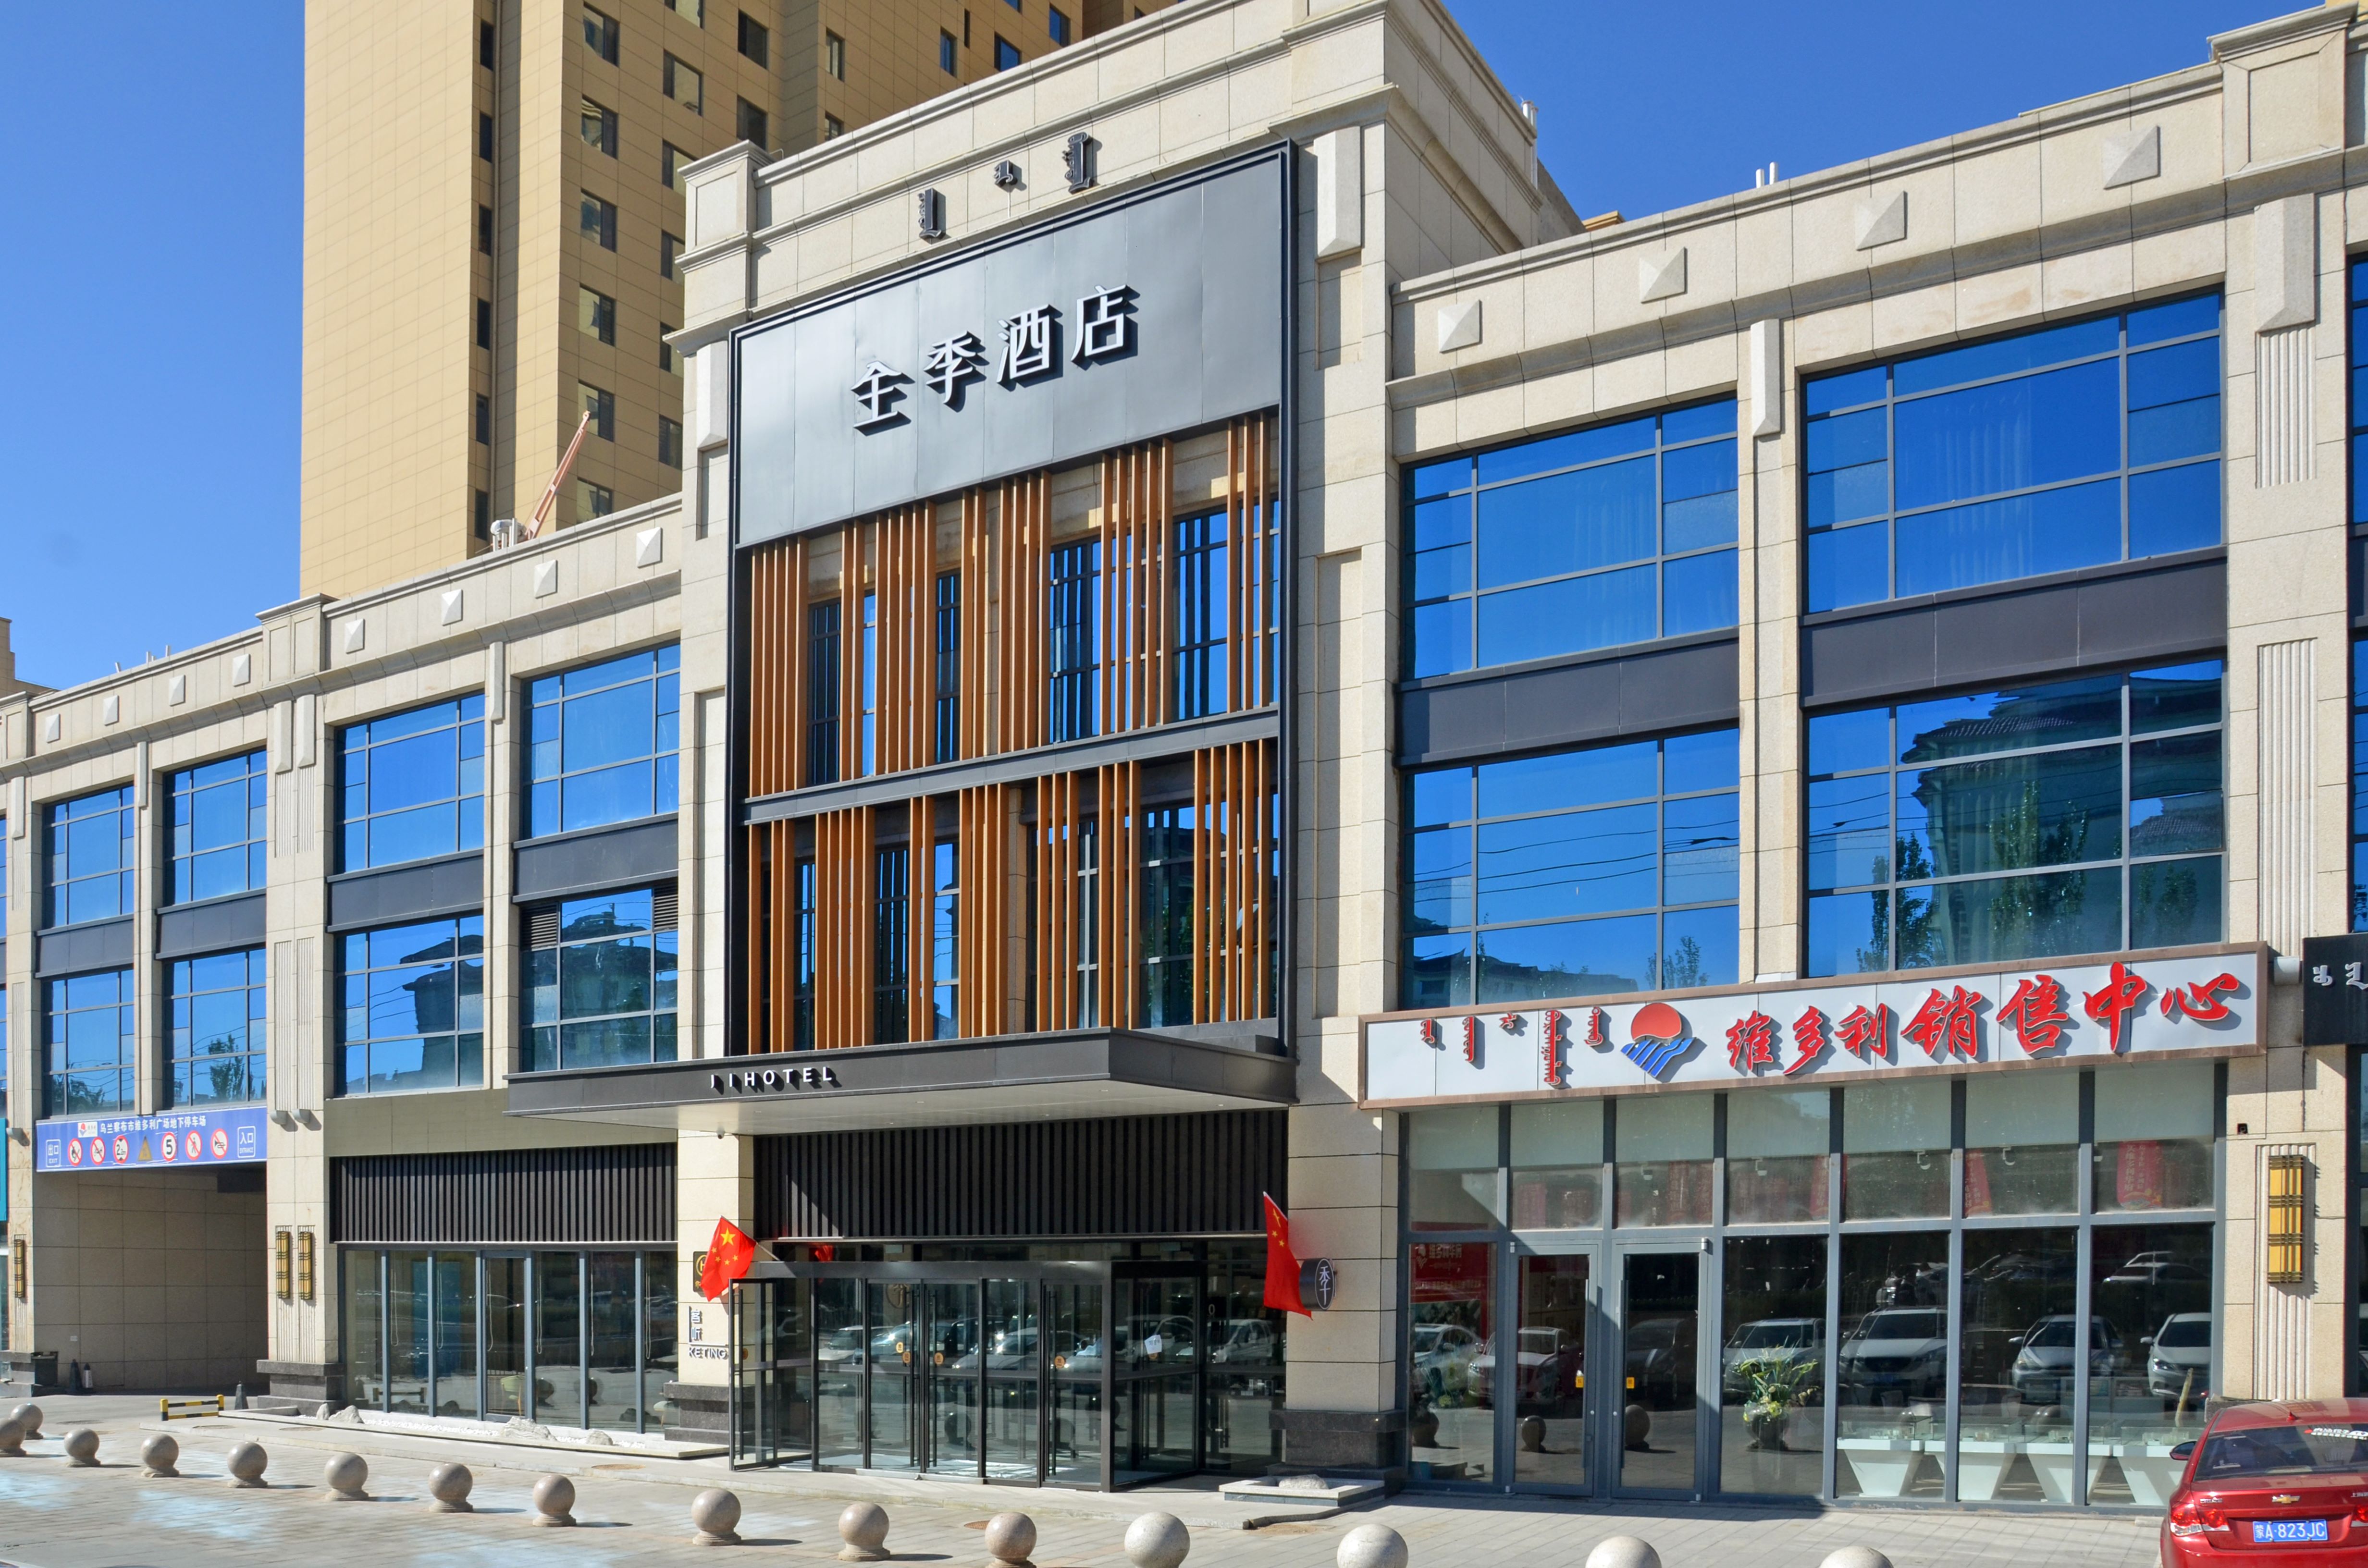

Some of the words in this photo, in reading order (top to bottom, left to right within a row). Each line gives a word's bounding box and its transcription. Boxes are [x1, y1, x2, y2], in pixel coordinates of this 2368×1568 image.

[850, 284, 1127, 429] 全季酒店
[1725, 961, 2240, 1075] 维多利销售中心
[744, 1066, 832, 1087] HOTEL
[100, 1115, 207, 1134] 乌兰察布市维多利广场地下停车场
[240, 1132, 254, 1144] 入口
[48, 1144, 59, 1156] 出口
[166, 1139, 173, 1155] 5
[689, 1347, 727, 1359] KETING
